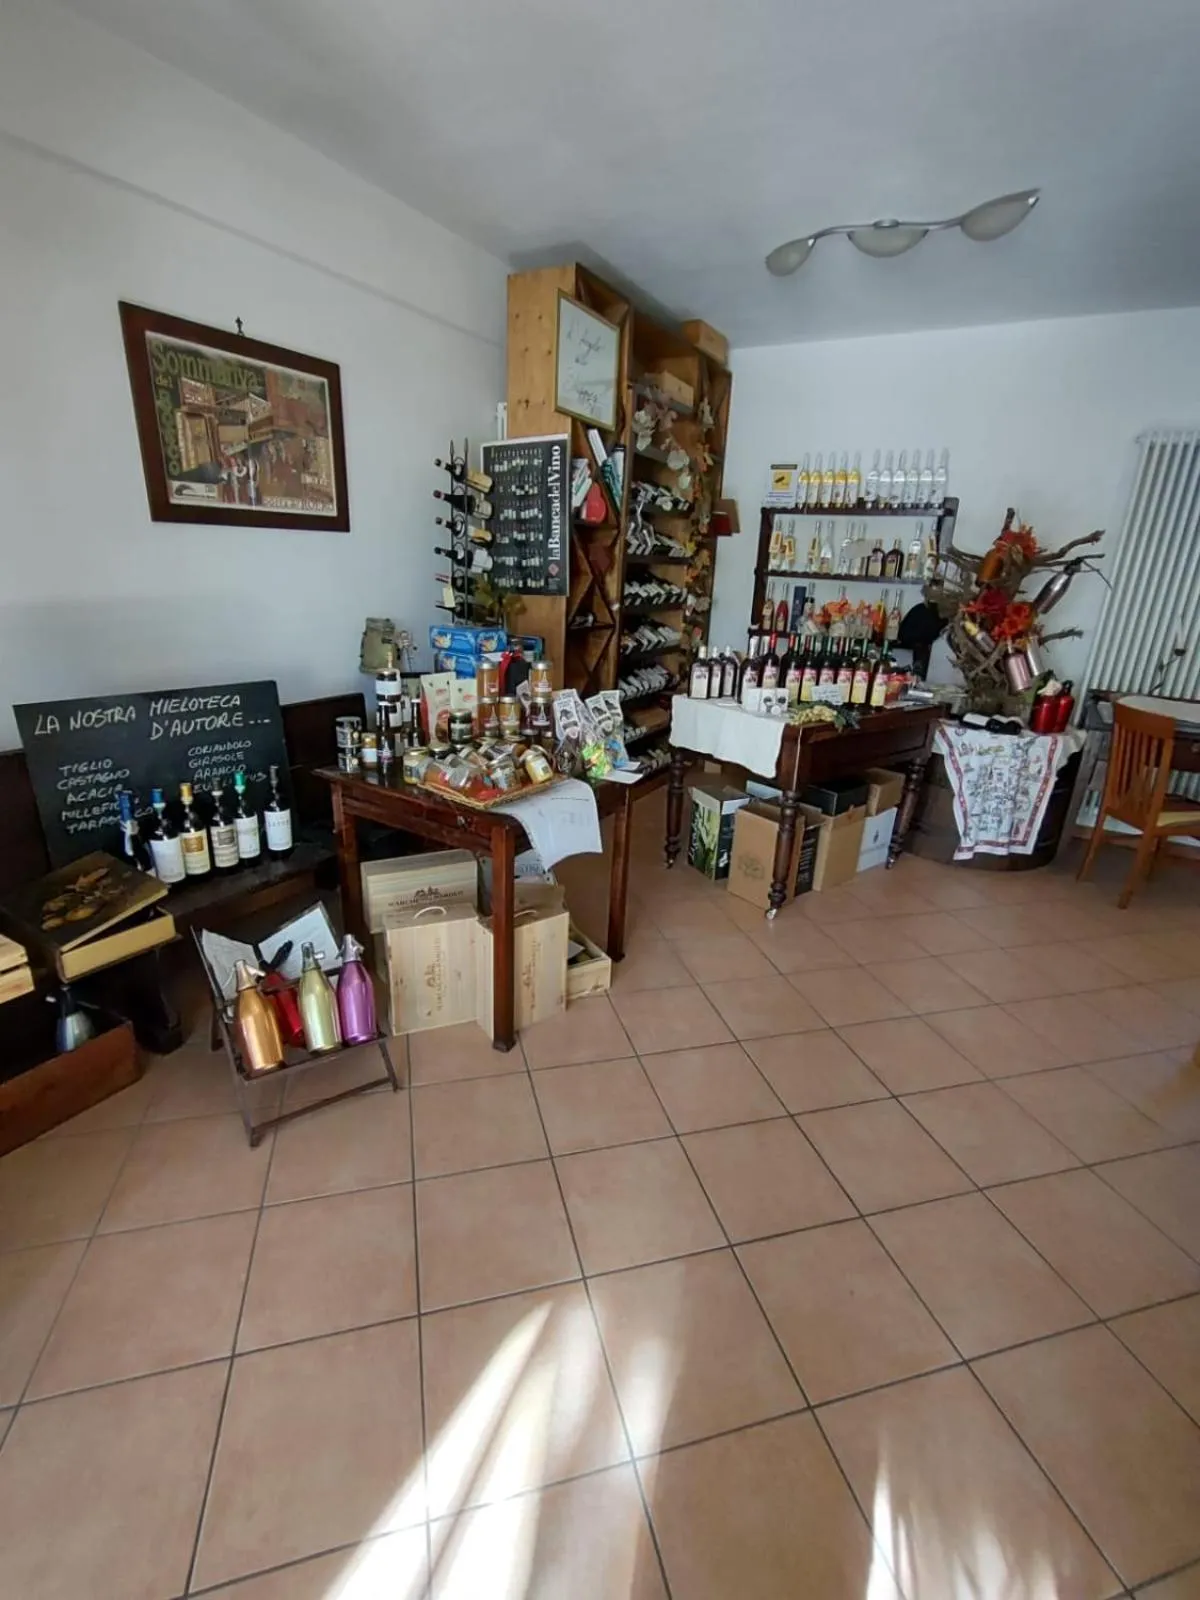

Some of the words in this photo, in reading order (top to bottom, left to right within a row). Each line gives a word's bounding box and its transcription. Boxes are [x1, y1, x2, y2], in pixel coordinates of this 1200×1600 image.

[34, 715, 60, 735] LA
[69, 705, 136, 731] NOSTRA
[149, 694, 241, 716] MIELOTECA
[188, 739, 252, 757] CORIANDOLO
[59, 758, 113, 777] TIGLIO
[188, 751, 245, 769] GIRASOLE
[56, 769, 130, 790] CASTAGNO
[193, 764, 247, 781] ARANCIO
[66, 783, 124, 805] ACACIA
